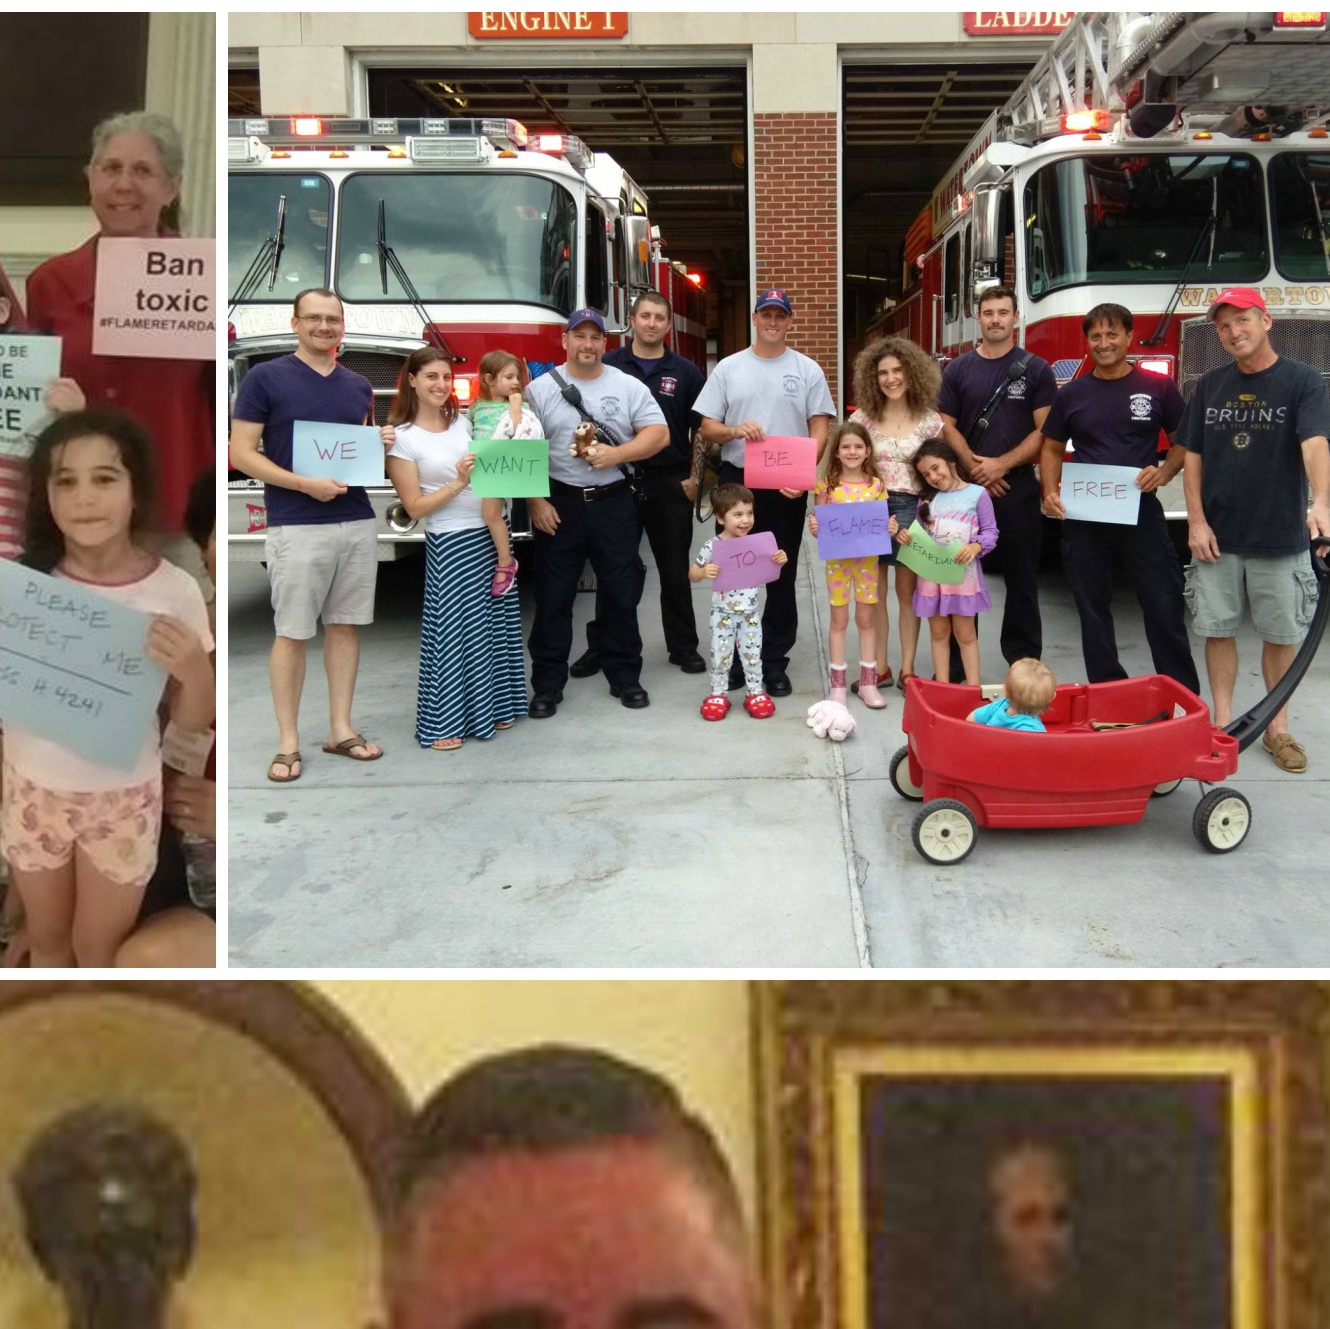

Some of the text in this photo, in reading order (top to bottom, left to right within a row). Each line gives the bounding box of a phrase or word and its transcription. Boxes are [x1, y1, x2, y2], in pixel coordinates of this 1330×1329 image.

[480, 12, 592, 31] ENGINE
[974, 12, 1075, 28] LADDE
[147, 251, 203, 276] Ban
[136, 289, 209, 312] toxic
[100, 317, 216, 331] #FLAMERETARDA
[238, 307, 418, 335] WATTOWN
[9, 346, 28, 358] BE
[1205, 407, 1287, 424] BRUINS
[313, 439, 357, 461] WE
[762, 451, 793, 468] BE
[478, 456, 541, 476] WANT
[1073, 481, 1128, 499] FREE
[828, 518, 884, 537] FLAME
[729, 550, 757, 569] TO
[25, 582, 111, 628] PLEASE
[102, 651, 144, 676] ME
[55, 684, 104, 718] 4241
